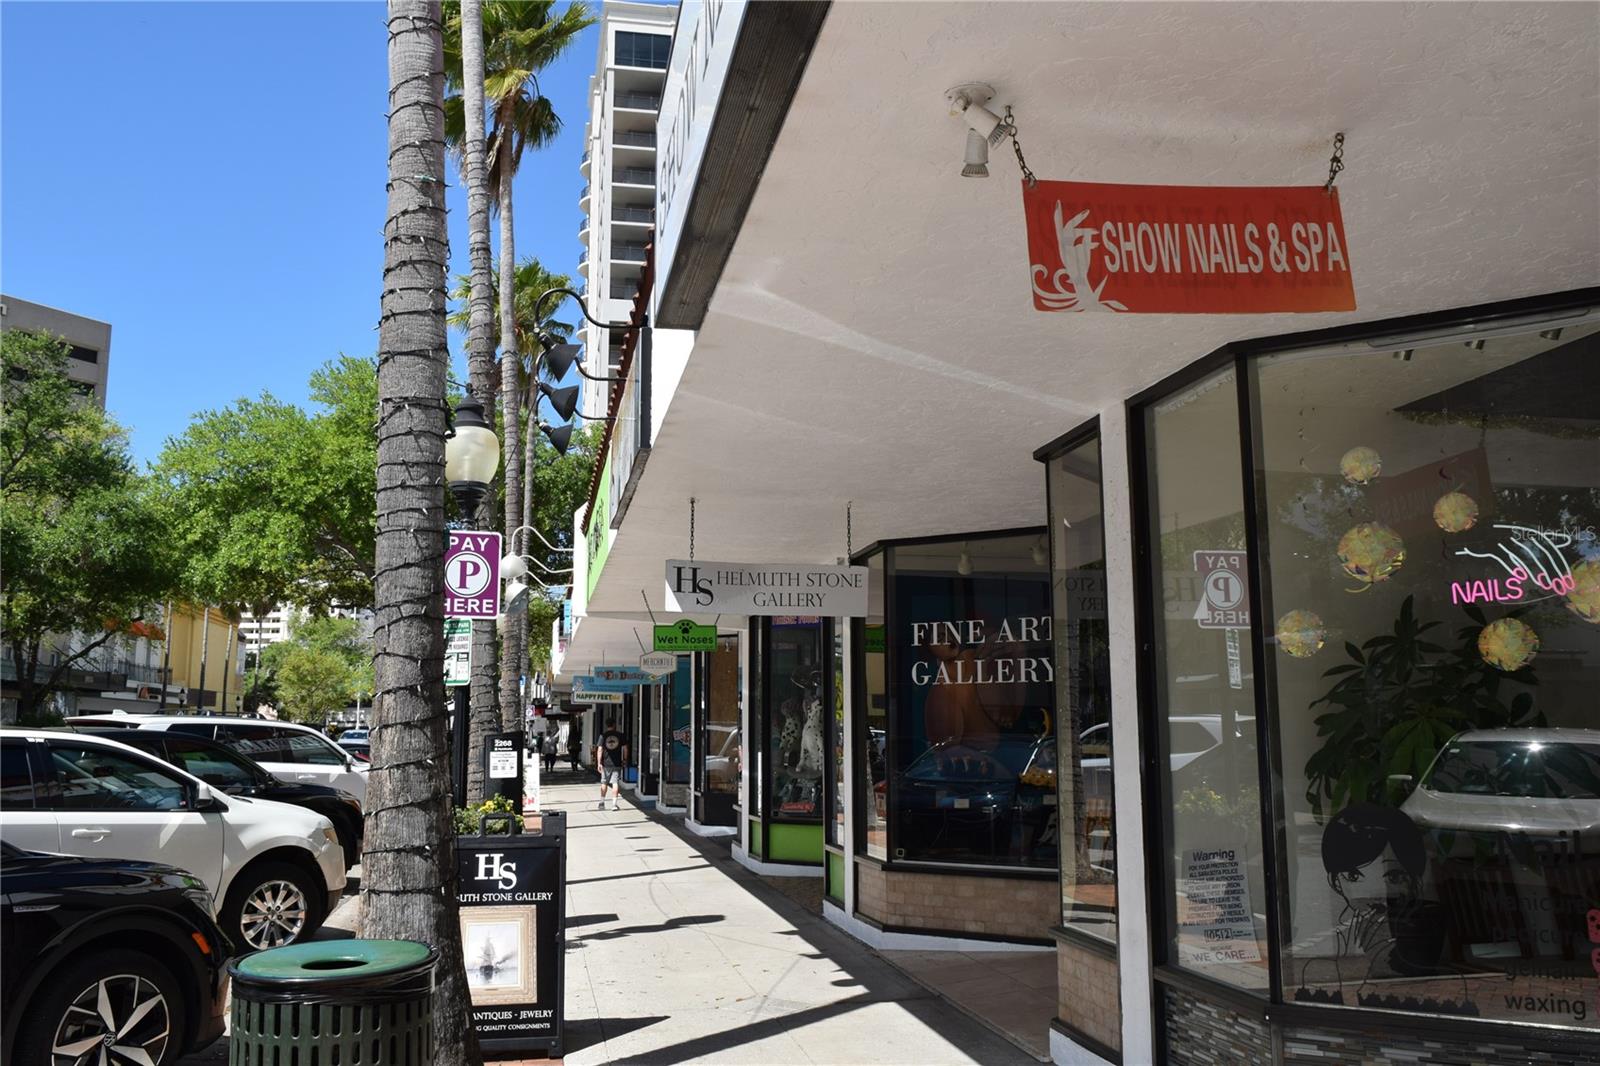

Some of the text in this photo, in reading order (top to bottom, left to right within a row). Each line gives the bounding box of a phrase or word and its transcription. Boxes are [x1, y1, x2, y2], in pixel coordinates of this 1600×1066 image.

[660, 18, 699, 238] SHOW
[1102, 221, 1347, 273] SHOW NAILS & SPA
[449, 537, 489, 551] PAY
[457, 559, 481, 589] P
[717, 571, 863, 589] HELMUTH STONE
[673, 566, 714, 606] HS
[1451, 577, 1524, 605] NAILS
[753, 592, 827, 608] GALLERY
[657, 635, 714, 644] Wet Noses
[911, 619, 985, 647] FINE
[911, 657, 1053, 686] GALLERY
[576, 693, 596, 701] HAPPY
[1193, 849, 1235, 861] Warning
[474, 853, 517, 890] HS
[456, 892, 553, 902] UTH STONE GALLERY
[1193, 953, 1212, 962] WE
[519, 1010, 553, 1019] JEWELRY
[1504, 993, 1586, 1020] waxing
[508, 1022, 551, 1030] CONSIGNMENTS
